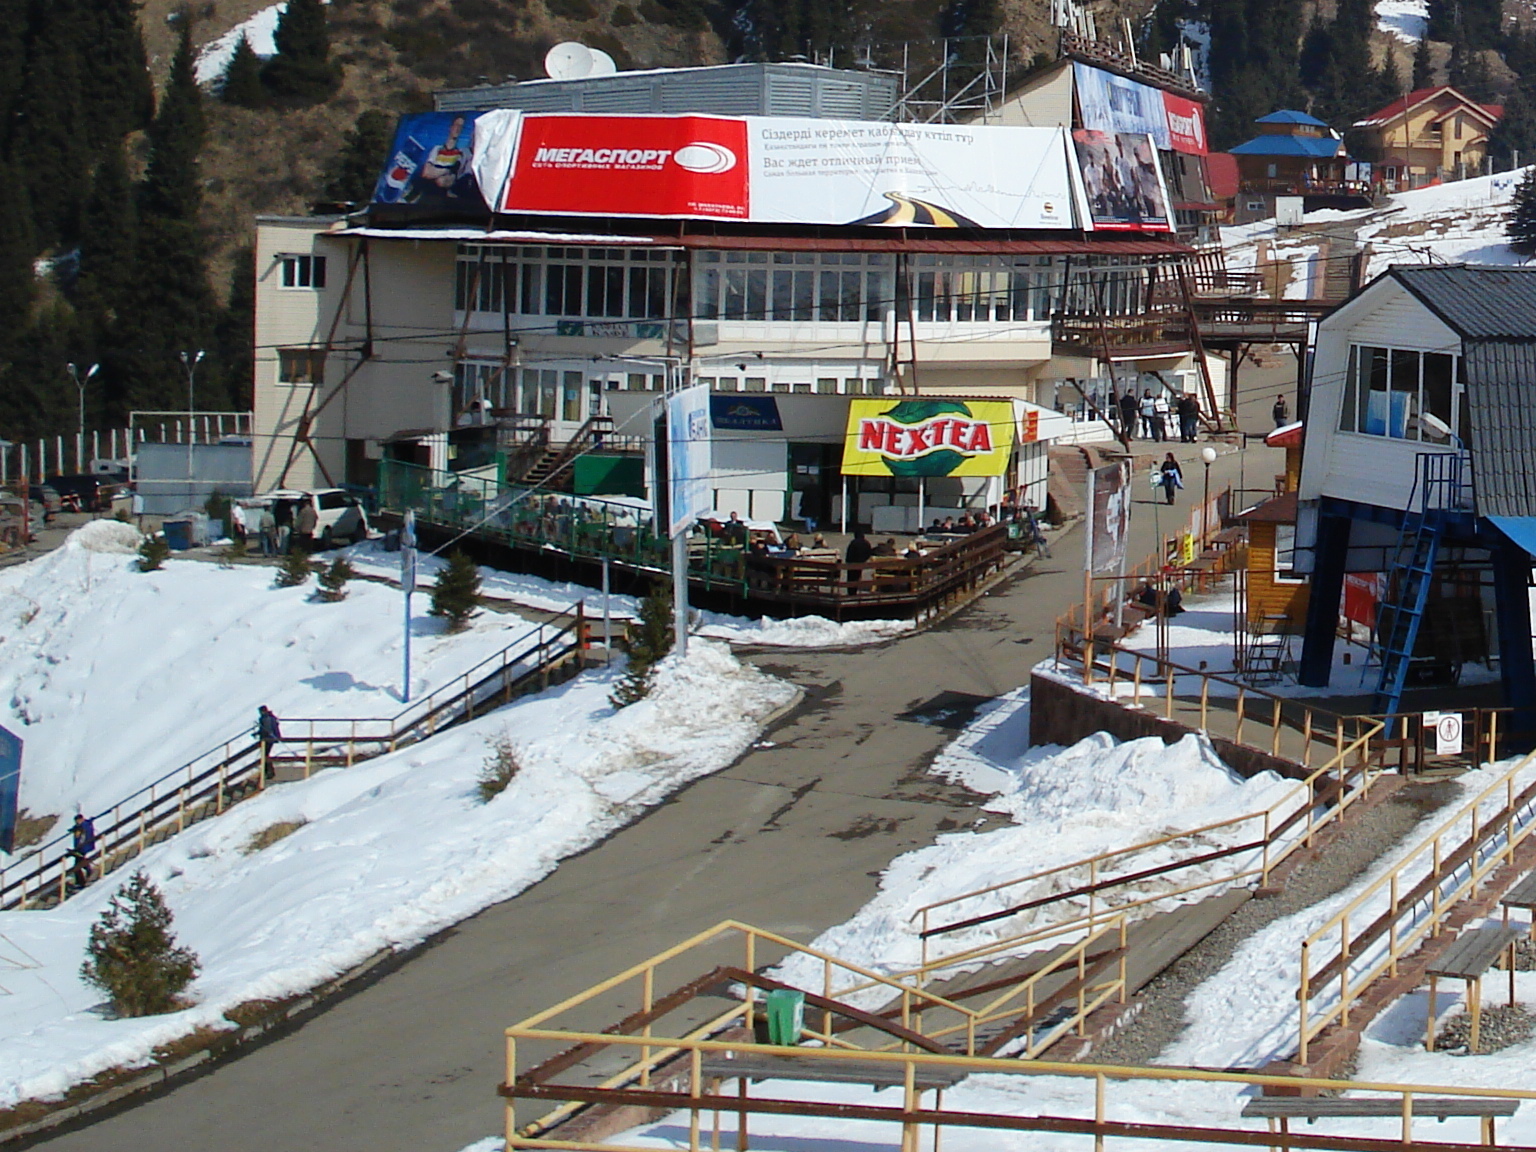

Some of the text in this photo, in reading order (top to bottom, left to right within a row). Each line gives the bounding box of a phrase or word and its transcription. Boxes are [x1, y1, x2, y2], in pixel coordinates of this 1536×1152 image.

[534, 147, 672, 165] МЕГАСПОРТ
[763, 157, 785, 168] Вас
[787, 158, 818, 168] ждет
[821, 154, 883, 166] отличный
